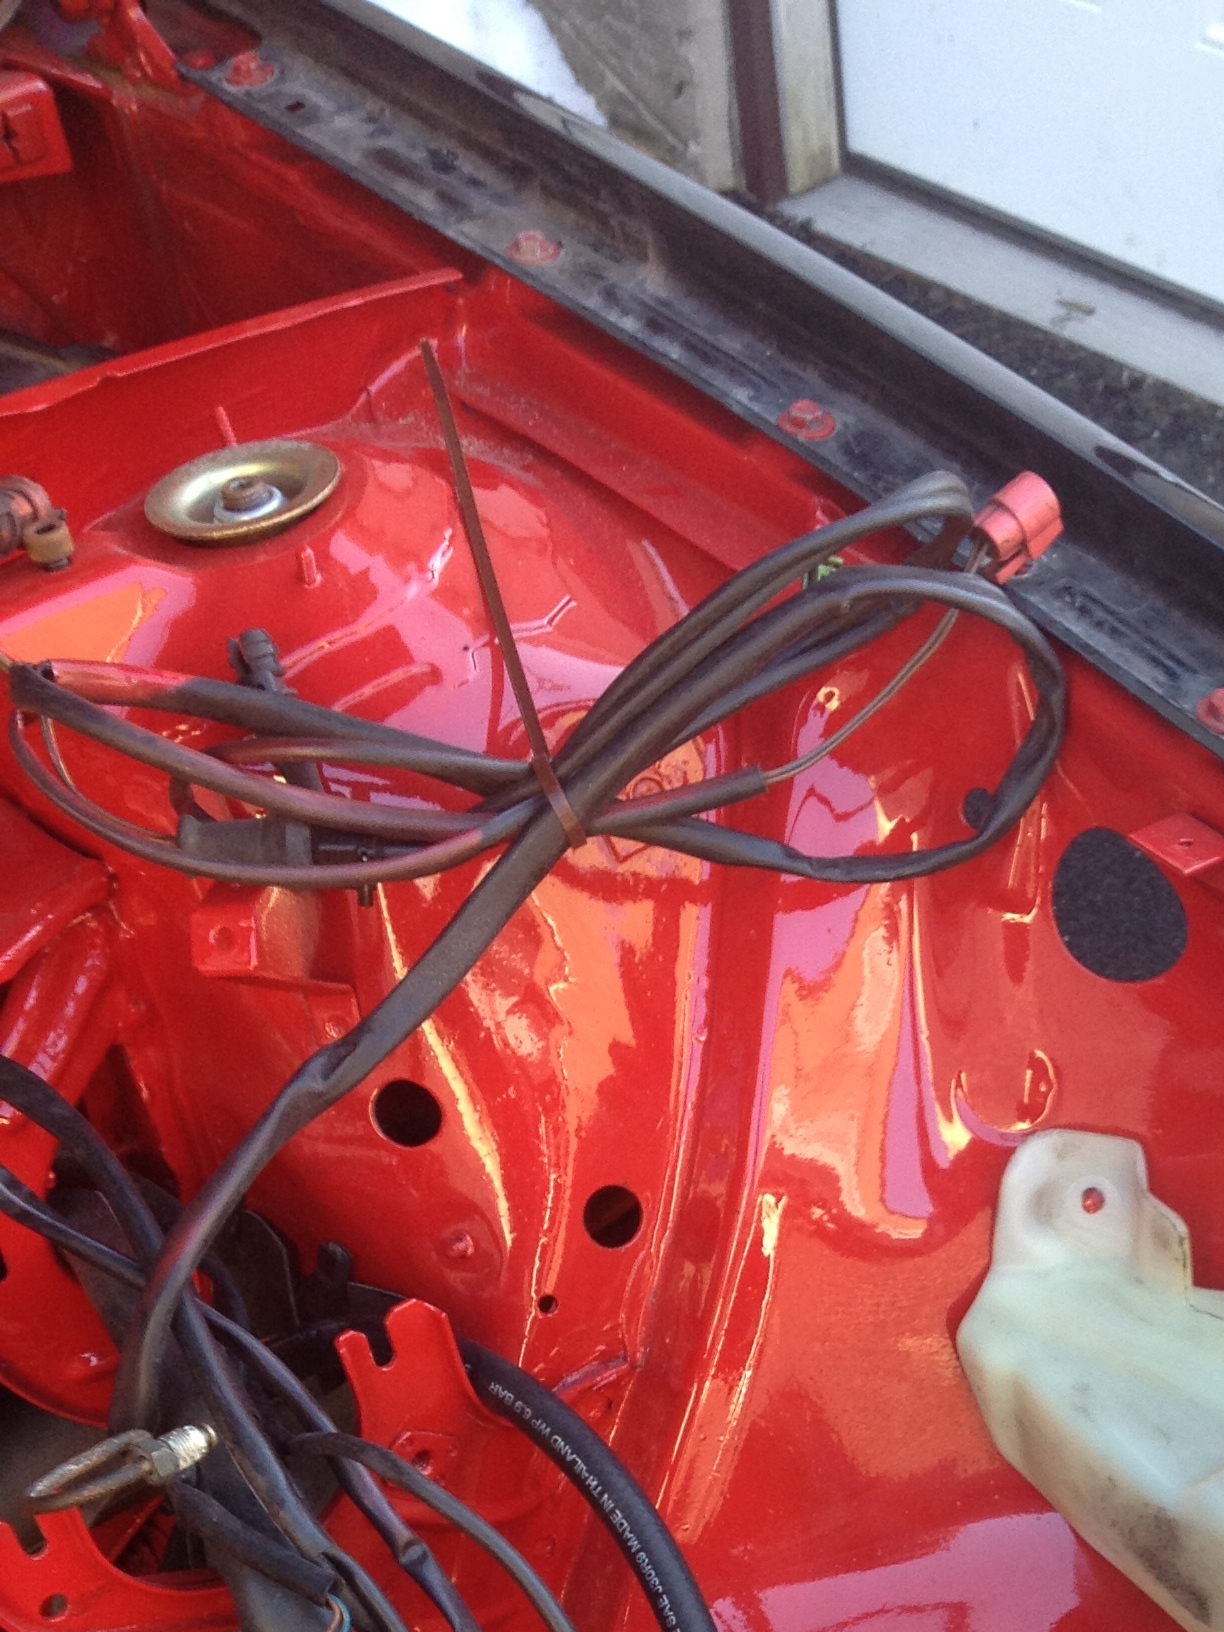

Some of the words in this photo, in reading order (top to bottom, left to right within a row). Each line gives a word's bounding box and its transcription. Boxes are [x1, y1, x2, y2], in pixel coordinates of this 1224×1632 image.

[488, 1381, 515, 1406] BAR
[513, 1400, 532, 1420] 6.9
[530, 1419, 551, 1437] WP
[550, 1435, 602, 1498] THAILAND
[600, 1493, 615, 1512] IN
[609, 1508, 642, 1553] MADE
[635, 1551, 663, 1594] J30R9
[657, 1594, 677, 1627] SAE
